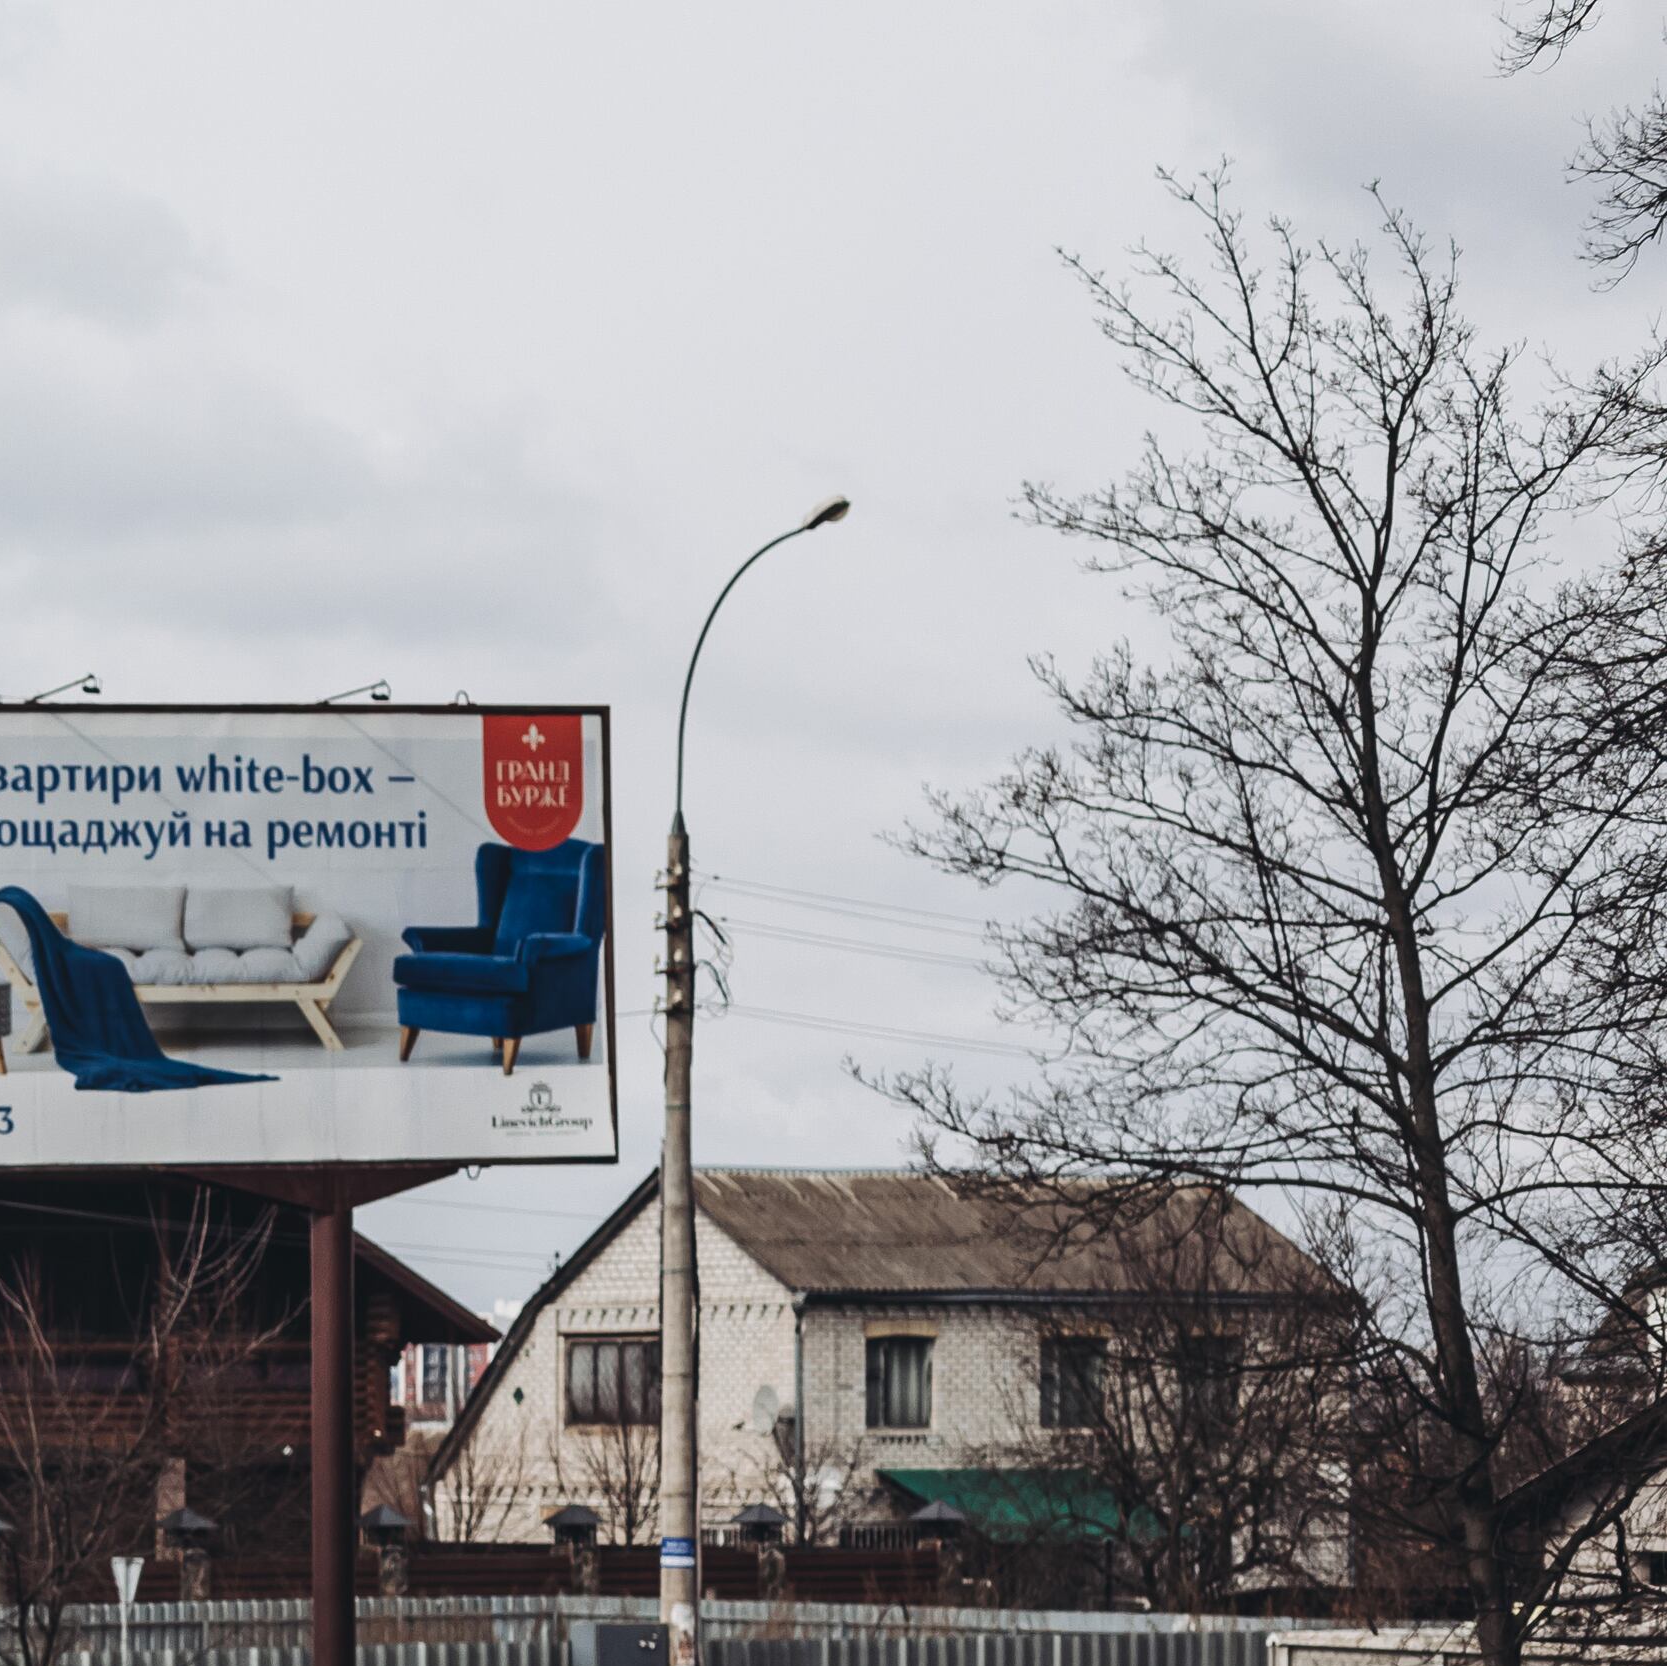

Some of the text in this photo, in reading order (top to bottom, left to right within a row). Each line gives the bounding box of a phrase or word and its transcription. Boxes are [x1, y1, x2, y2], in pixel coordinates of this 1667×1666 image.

[176, 753, 374, 793] white-box
[496, 759, 570, 784] ГРАНД
[497, 784, 568, 808] БУРЖЕ
[204, 820, 252, 848] на
[267, 810, 427, 860] ремонті
